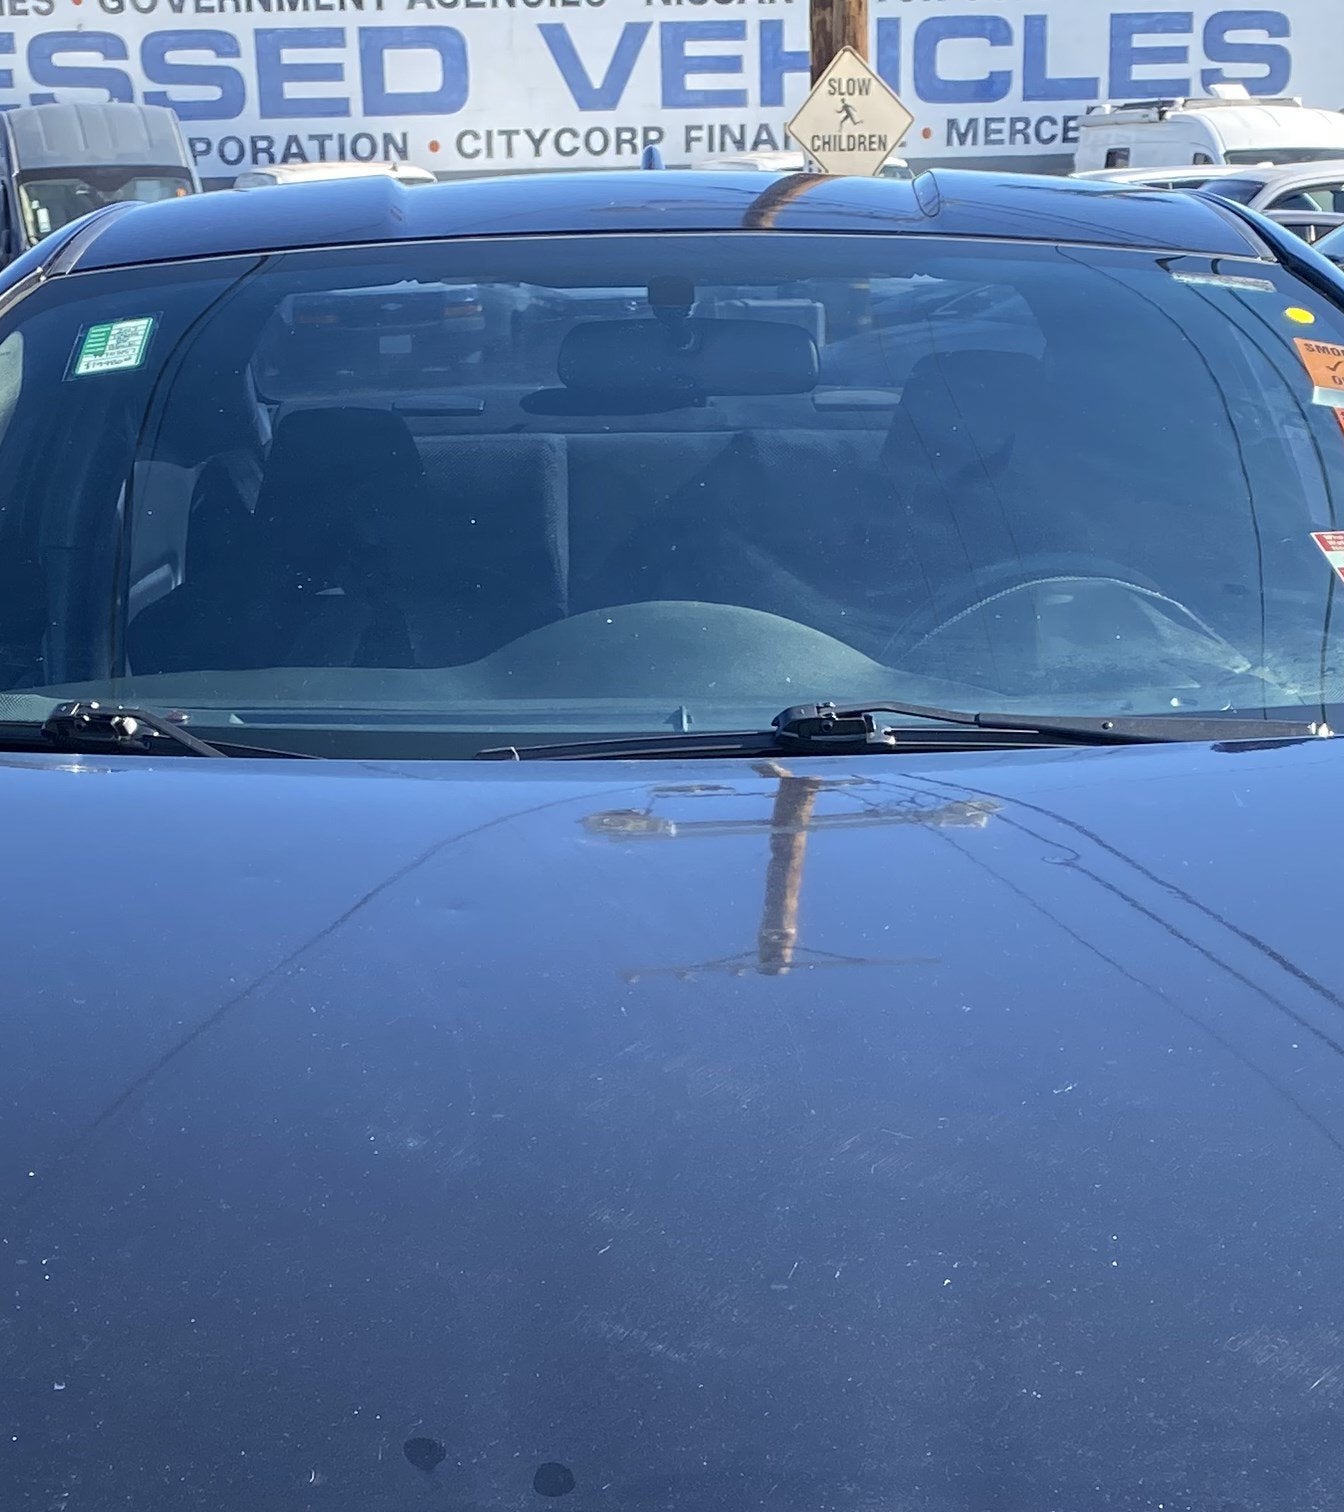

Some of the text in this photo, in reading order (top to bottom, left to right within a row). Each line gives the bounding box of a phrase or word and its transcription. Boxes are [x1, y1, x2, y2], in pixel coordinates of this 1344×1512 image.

[537, 9, 1293, 112] VEHICLES
[827, 78, 872, 96] SLOW
[455, 126, 666, 159] CITYCORP
[811, 134, 888, 152] CHILDREN
